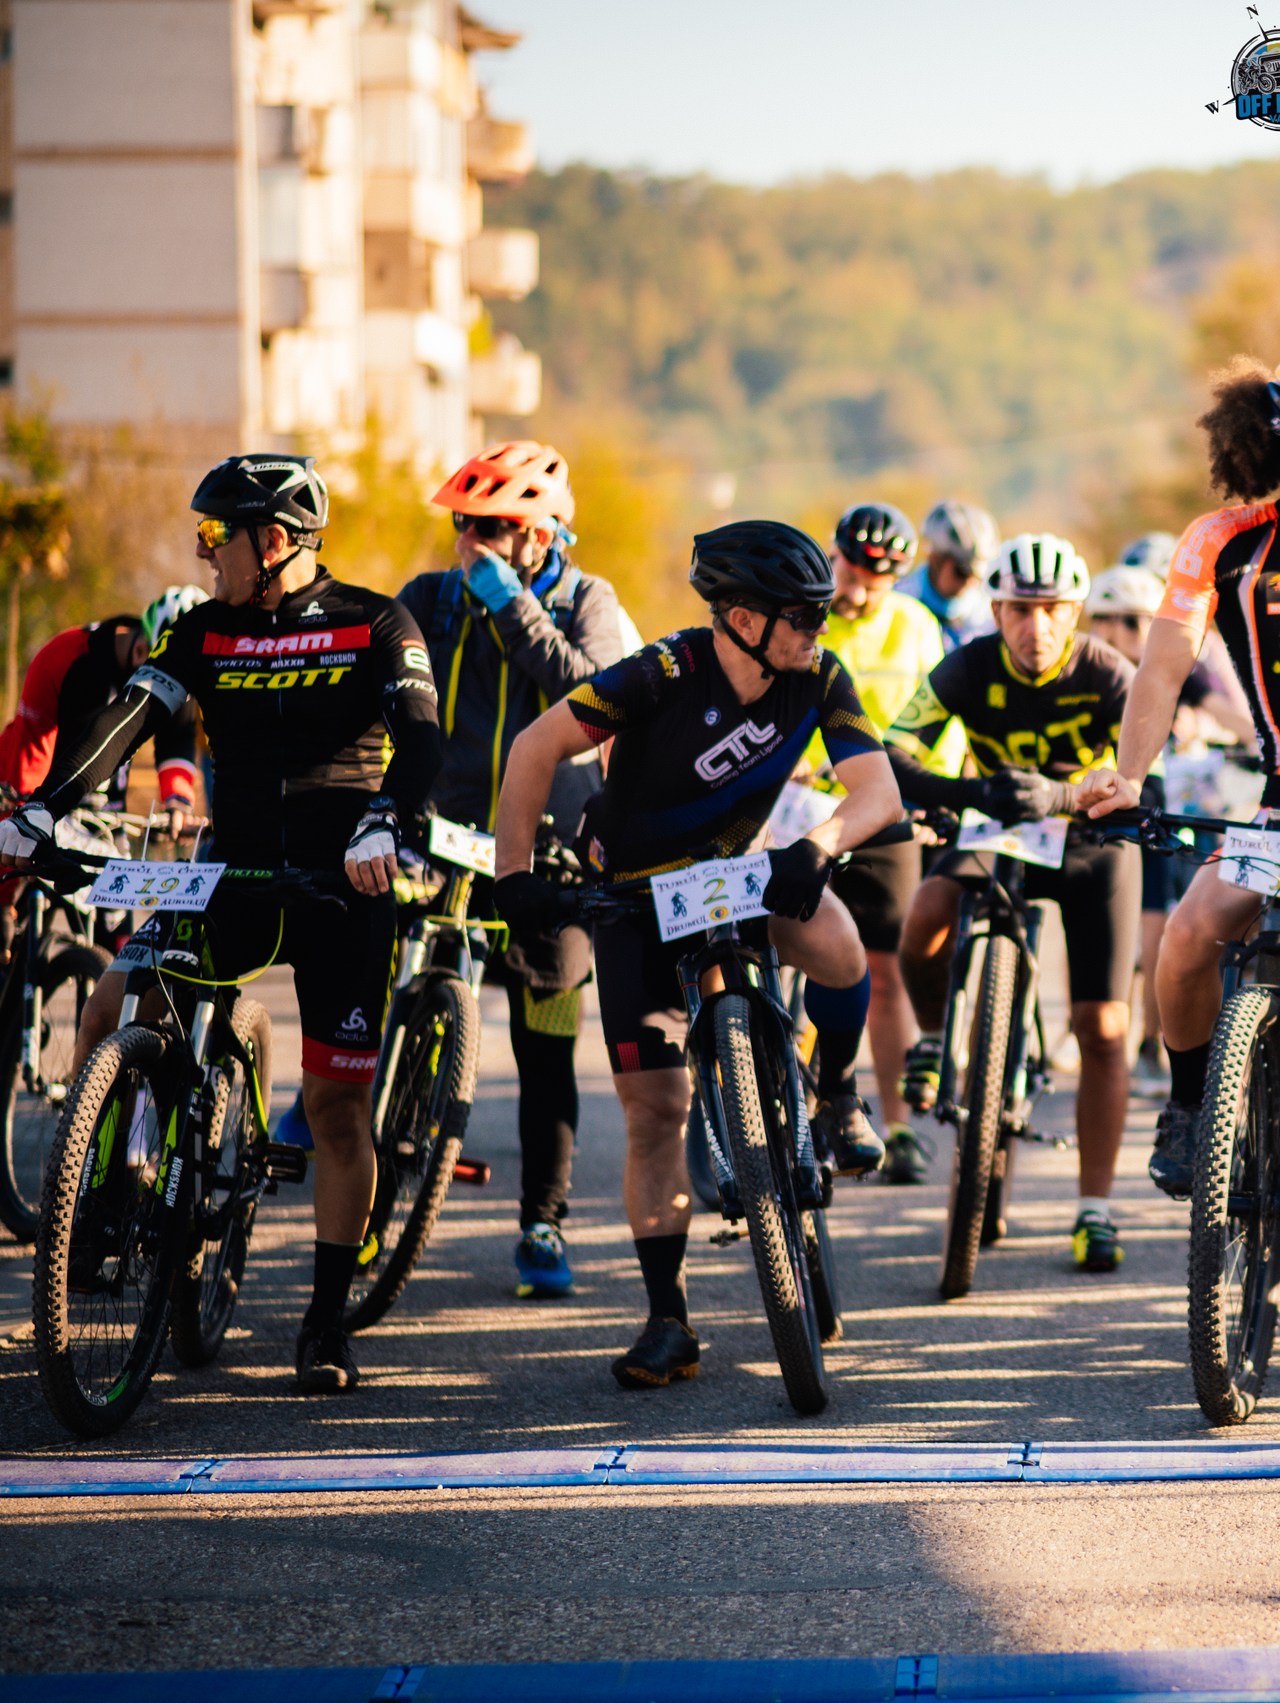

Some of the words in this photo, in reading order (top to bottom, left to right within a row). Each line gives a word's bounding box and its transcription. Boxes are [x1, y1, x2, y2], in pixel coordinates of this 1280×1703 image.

[234, 632, 333, 654] SRAM
[270, 658, 306, 670] MAXXIS
[319, 652, 357, 667] ROCKSHOX
[215, 666, 352, 689] SCOTT
[694, 718, 778, 782] CTL
[1230, 837, 1273, 853] TURUL
[110, 864, 153, 875] TURUL
[134, 877, 180, 895] 19
[656, 873, 701, 892] TURUL
[703, 878, 730, 906] 2
[165, 1156, 184, 1208] ROCKSHOX
